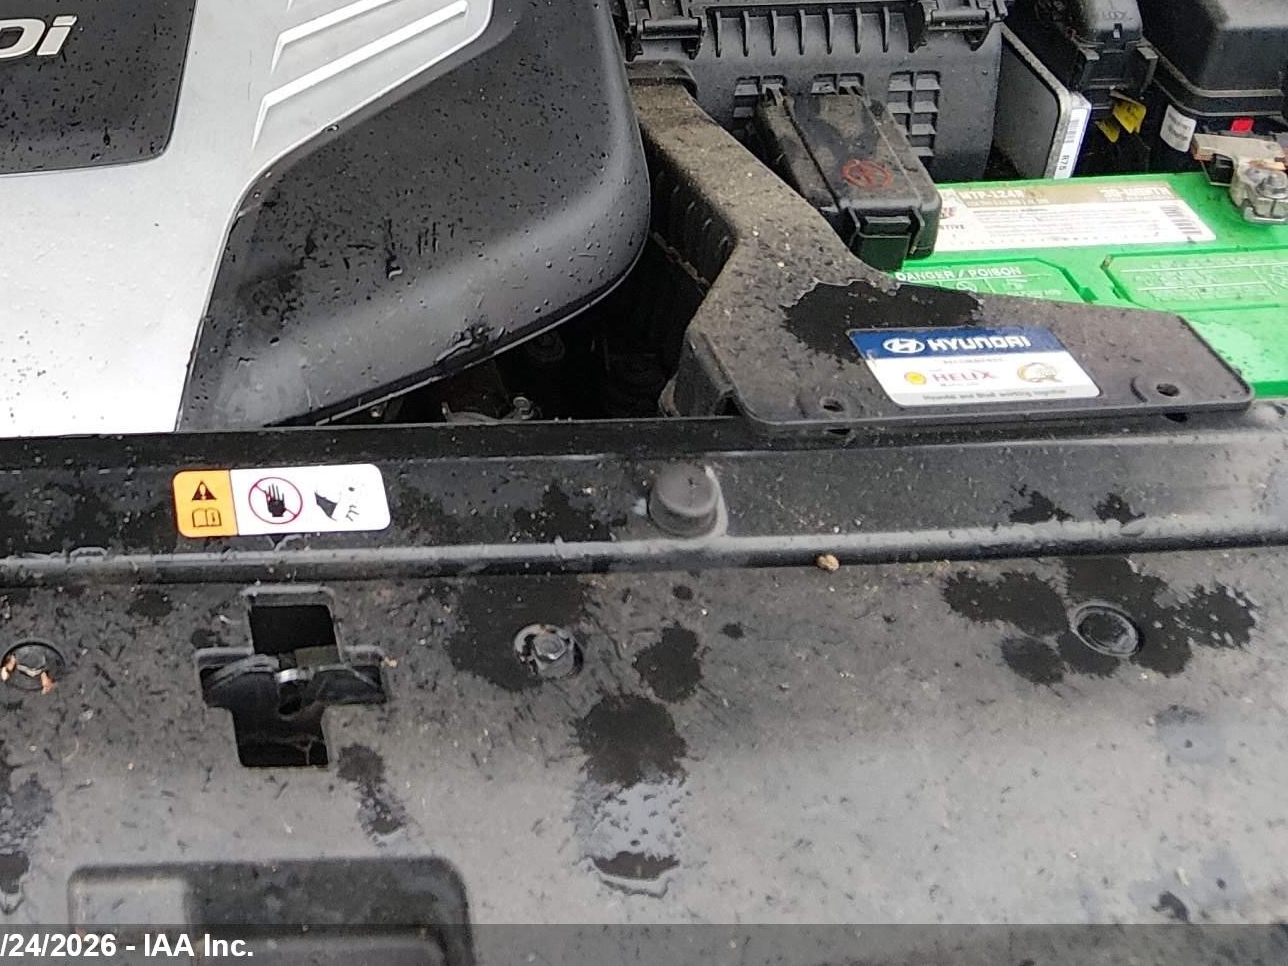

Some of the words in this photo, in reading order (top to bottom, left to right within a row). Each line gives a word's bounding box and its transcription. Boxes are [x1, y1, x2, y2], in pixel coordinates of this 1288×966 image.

[895, 270, 955, 281] DANGER
[967, 266, 1022, 277] POISON
[928, 336, 1031, 351] HYUNDAI
[933, 369, 998, 382] HELIX
